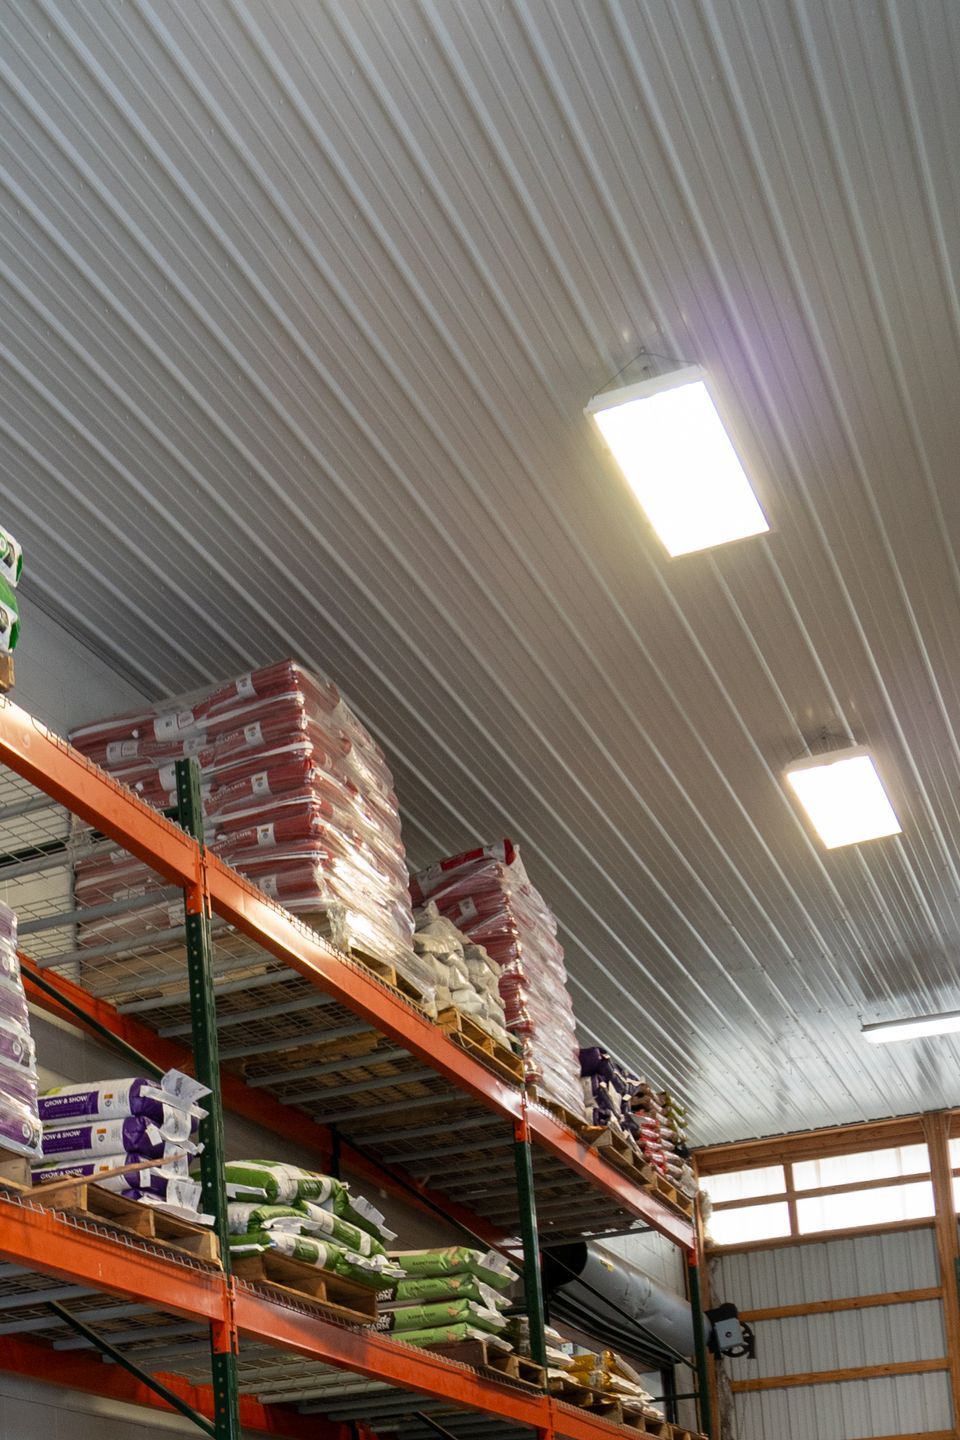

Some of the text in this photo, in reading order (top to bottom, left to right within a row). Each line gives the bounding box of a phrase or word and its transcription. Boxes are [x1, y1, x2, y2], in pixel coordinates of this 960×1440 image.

[44, 1099, 62, 1107] GROW
[69, 1095, 88, 1103] SHOW
[62, 1129, 81, 1138] SHOW
